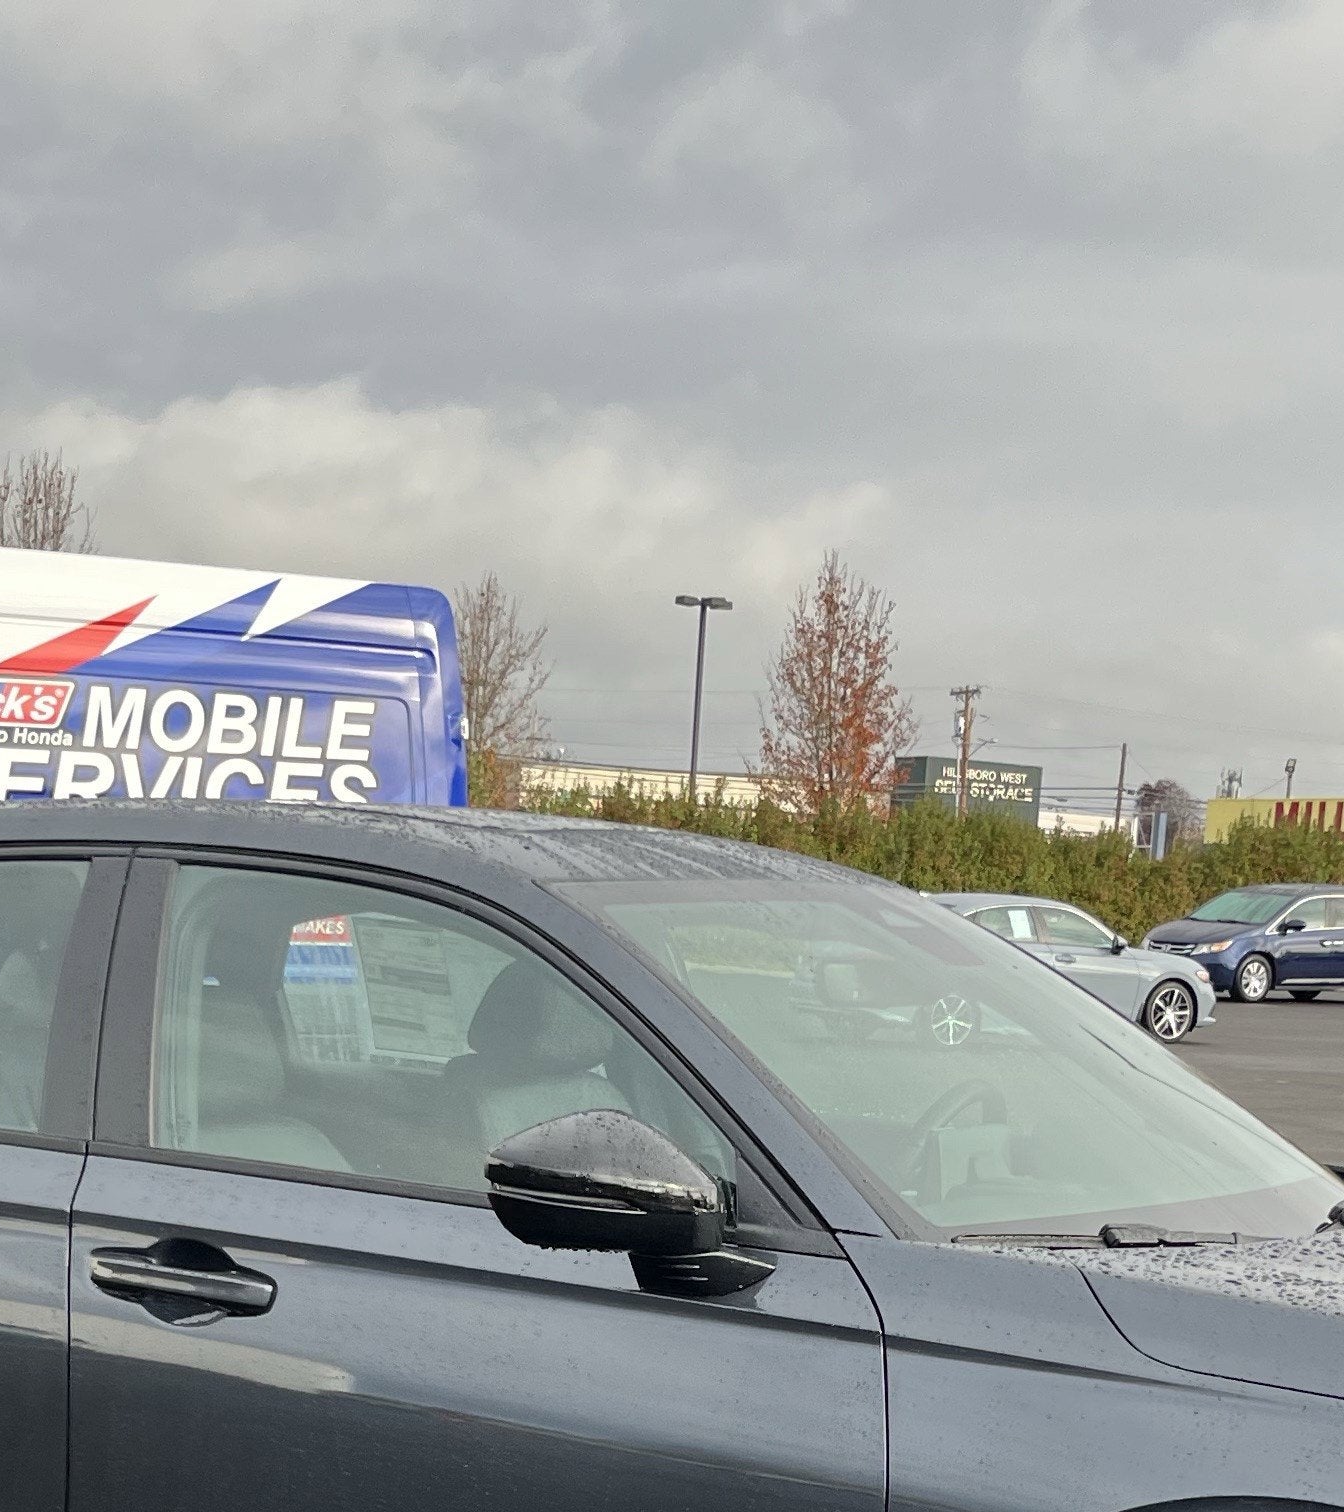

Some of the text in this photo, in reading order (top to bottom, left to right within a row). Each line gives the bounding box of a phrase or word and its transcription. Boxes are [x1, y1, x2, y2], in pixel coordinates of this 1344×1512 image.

[82, 686, 375, 761] MOBILE
[13, 728, 73, 747] Honda
[942, 766, 1027, 785] HILBORO WEST
